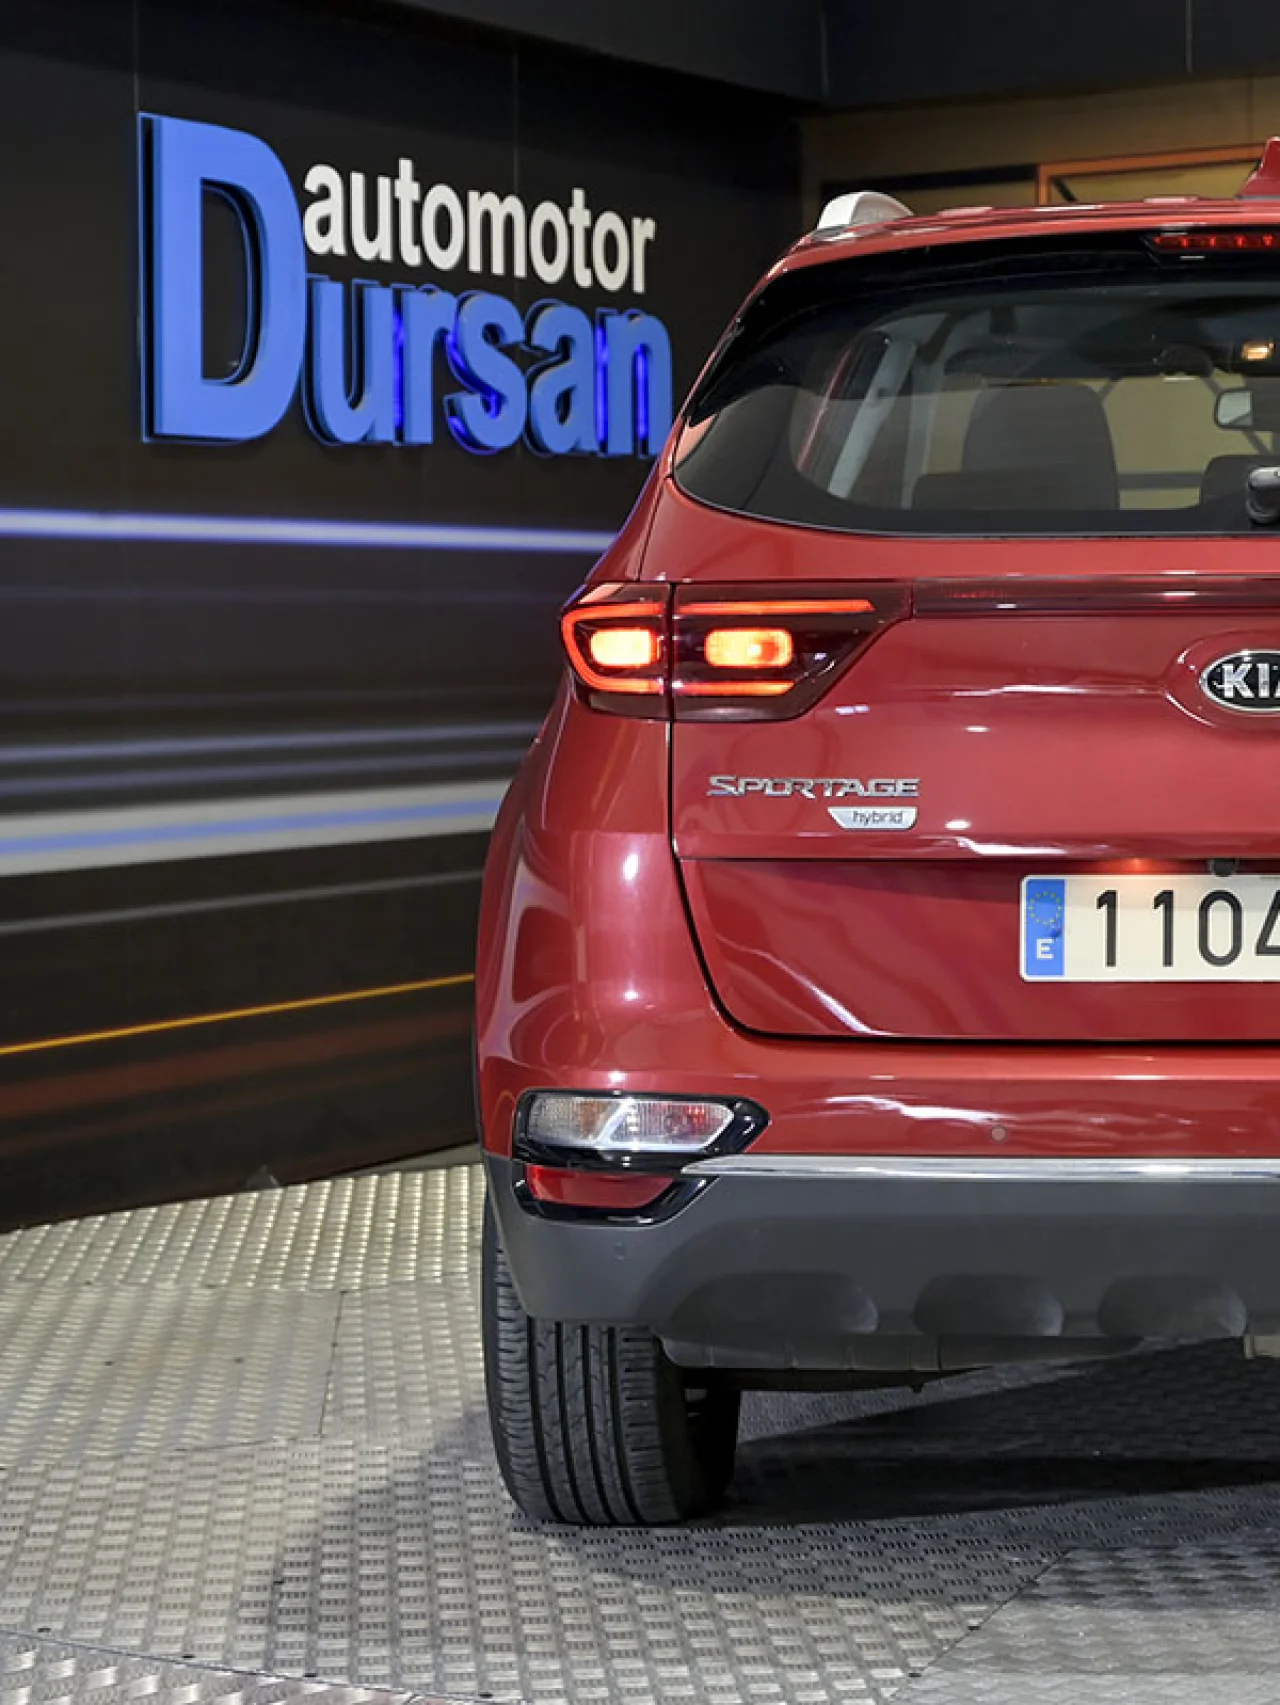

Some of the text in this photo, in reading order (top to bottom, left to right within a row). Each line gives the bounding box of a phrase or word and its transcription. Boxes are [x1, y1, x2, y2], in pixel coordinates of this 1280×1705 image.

[303, 157, 656, 293] automotor
[138, 112, 673, 456] Dursan
[706, 775, 921, 799] SPORTAGE
[852, 810, 904, 827] hybrid
[1035, 938, 1054, 960] E
